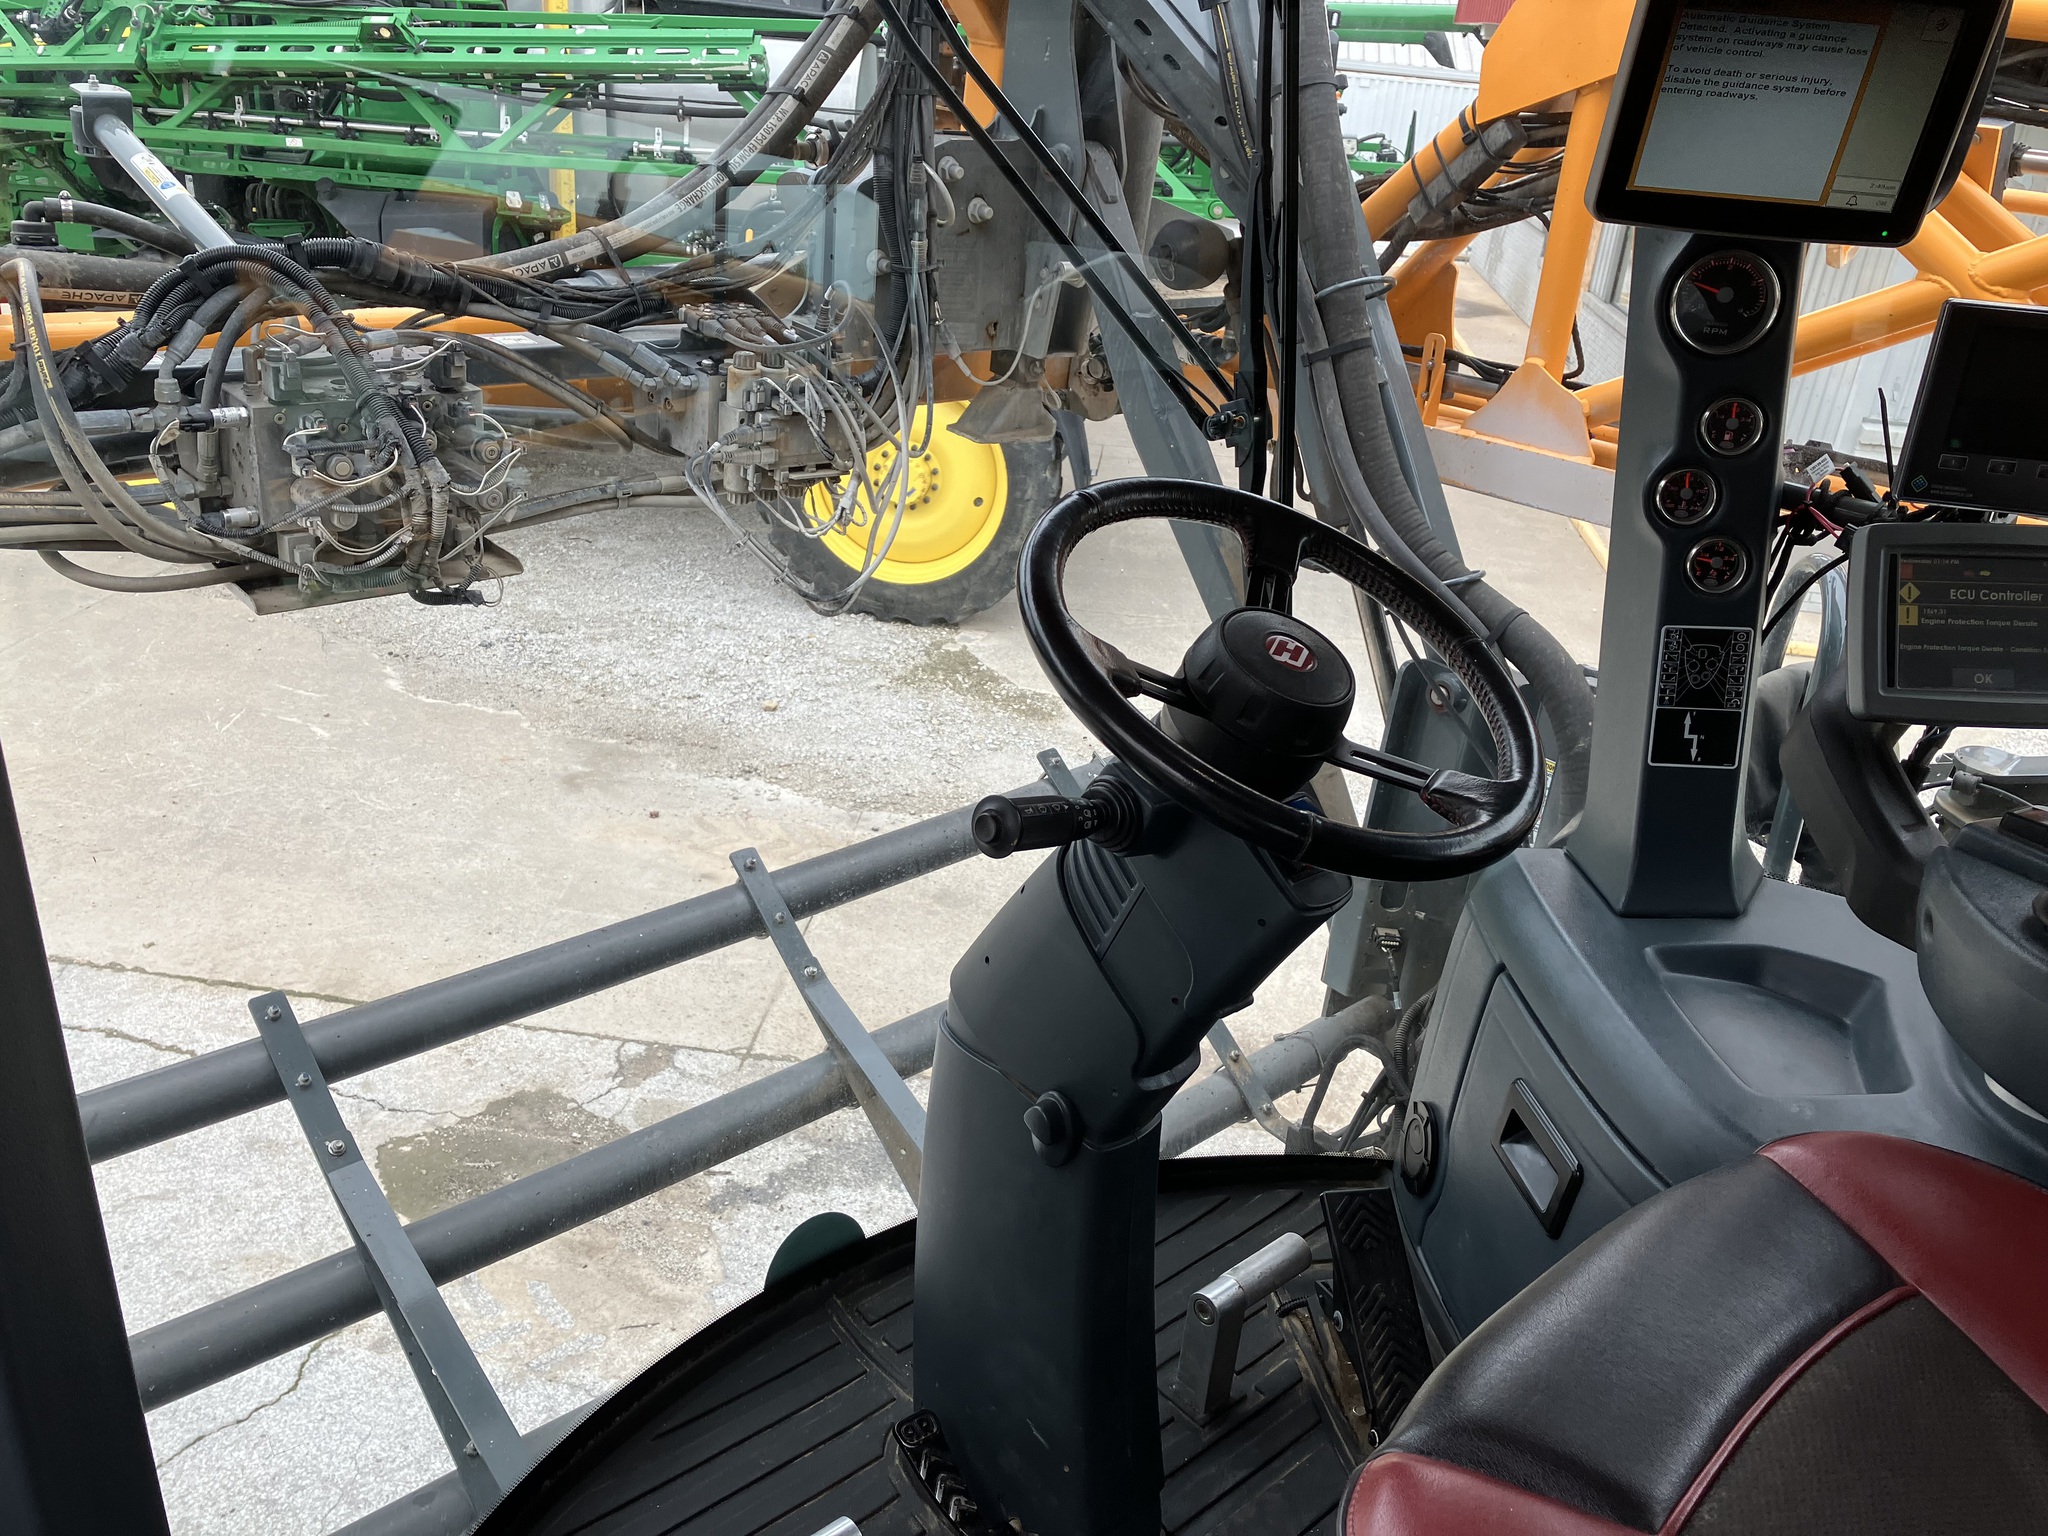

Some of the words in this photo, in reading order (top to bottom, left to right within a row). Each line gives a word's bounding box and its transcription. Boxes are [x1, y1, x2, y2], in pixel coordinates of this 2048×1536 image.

[1682, 11, 1735, 23] Automatic
[1738, 15, 1788, 27] Guidance
[1791, 19, 1831, 31] System
[1680, 22, 1727, 33] Detected.
[1734, 27, 1787, 39] Activating
[1799, 31, 1847, 43] guidance
[1676, 34, 1713, 44] system
[1733, 38, 1784, 50] roadways
[1787, 41, 1809, 52] may
[1812, 44, 1843, 54] cause
[1846, 47, 1868, 56] loss
[1687, 45, 1723, 54] vehicle
[1726, 50, 1764, 58] control.
[799, 61, 822, 90] APAC
[1668, 64, 1680, 72] To
[1683, 66, 1711, 75] avoid
[1714, 68, 1742, 77] death
[1760, 72, 1798, 82] serious
[1800, 75, 1833, 87] injury,
[1661, 86, 1703, 97] entering
[1706, 90, 1758, 101] roadways.
[1664, 75, 1701, 85] disable
[1704, 77, 1720, 86] the
[1722, 80, 1769, 90] guidance
[1772, 84, 1809, 93] system
[1813, 87, 1847, 97] before
[61, 290, 128, 302] APACHE
[1703, 326, 1729, 337] RPM
[1950, 589, 1976, 601] ECU
[1980, 590, 2044, 602] Controller
[1921, 618, 1946, 626] Engine
[1948, 618, 1985, 626] Protection
[1986, 619, 2011, 628] Torque
[1974, 673, 1994, 685] OK
